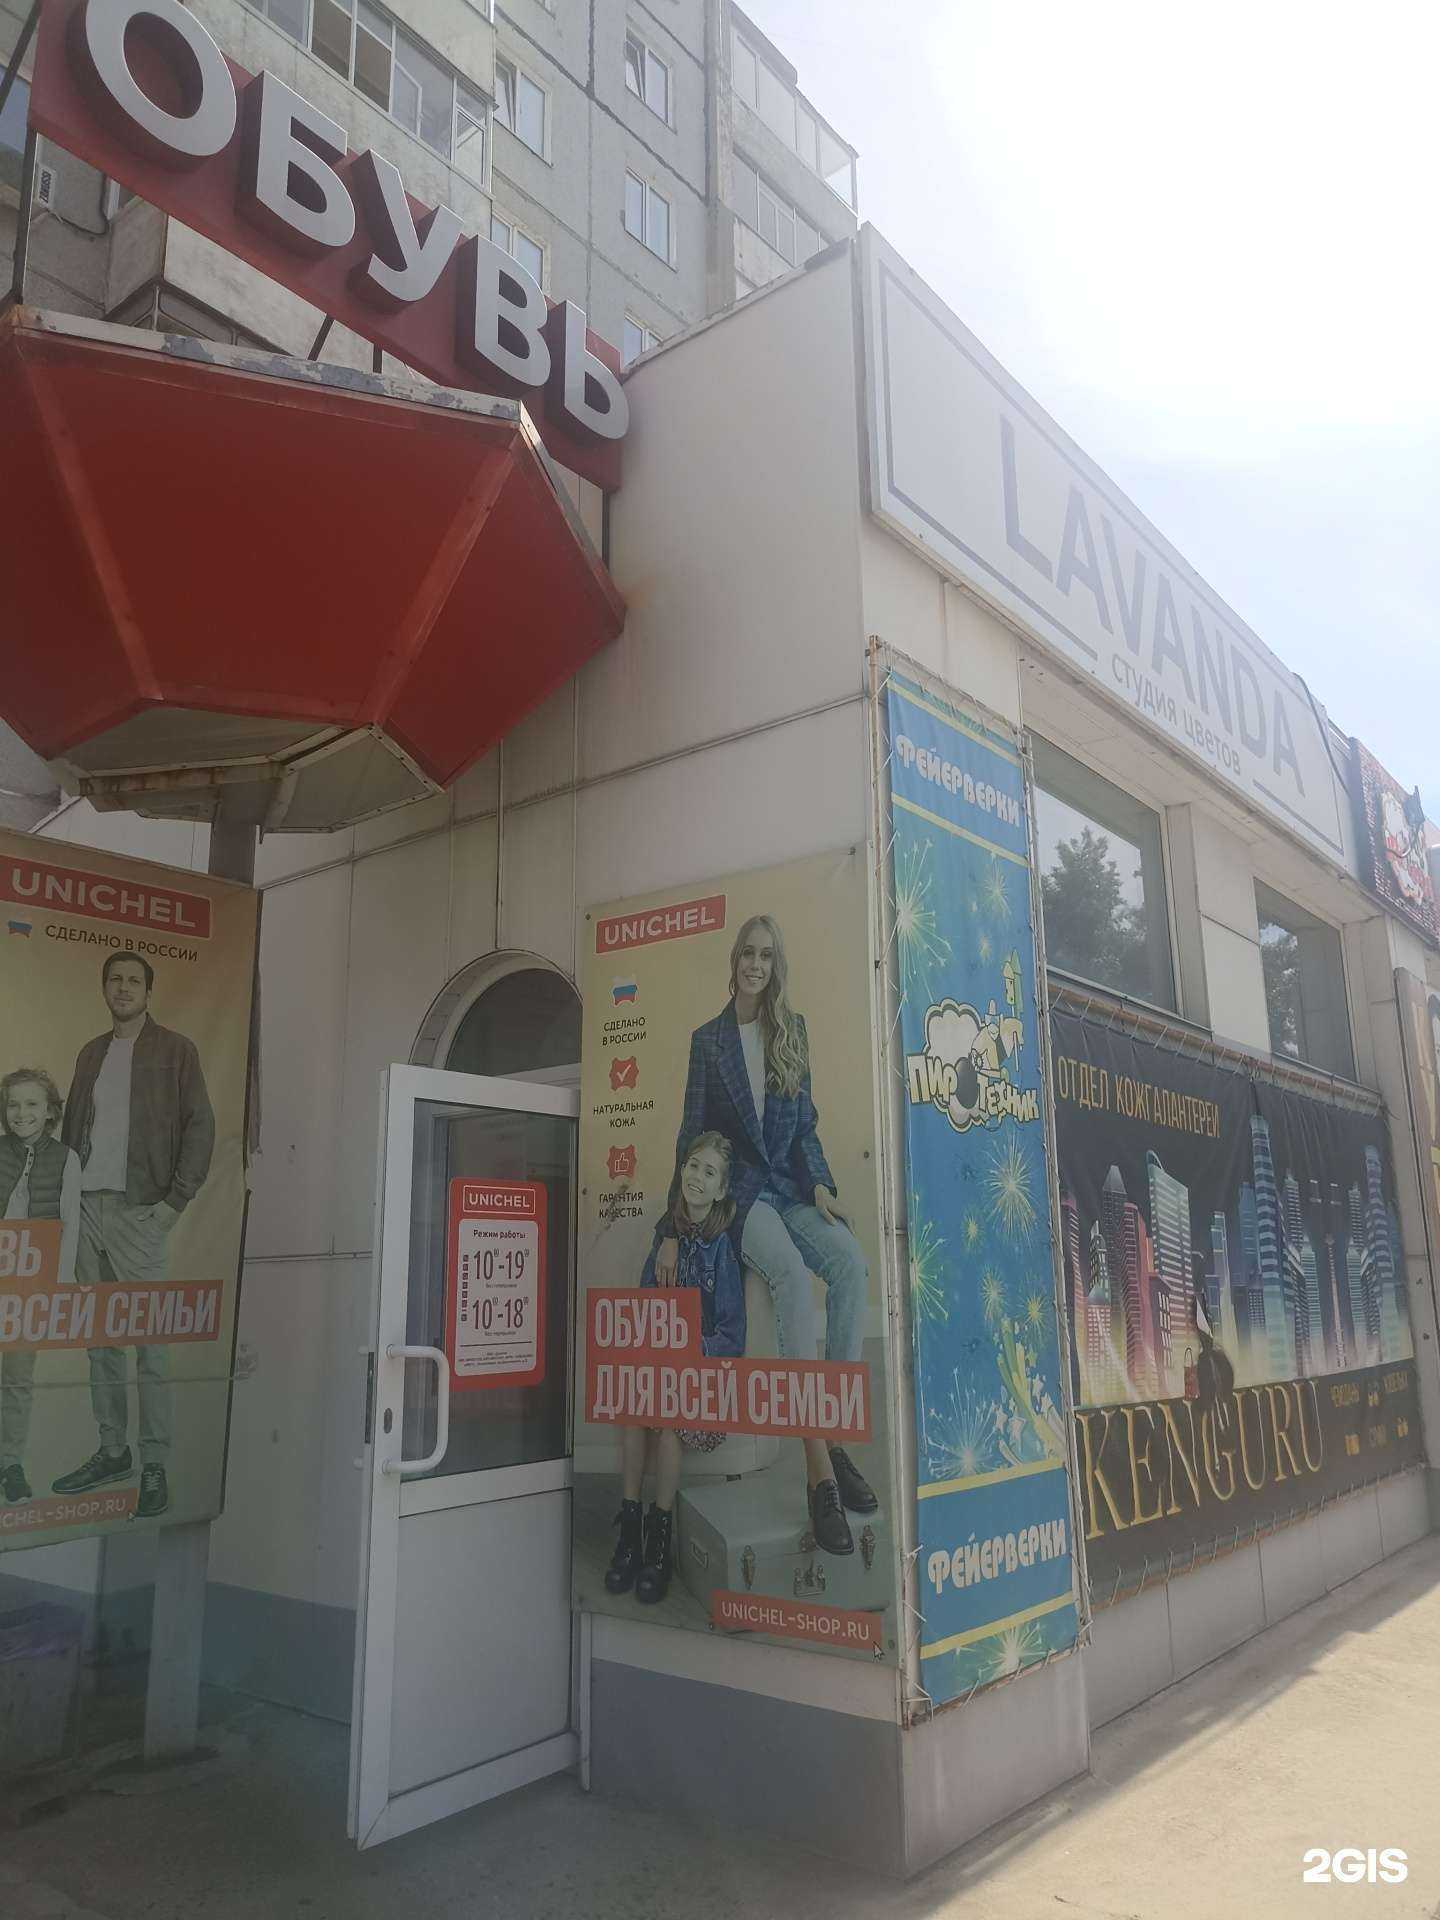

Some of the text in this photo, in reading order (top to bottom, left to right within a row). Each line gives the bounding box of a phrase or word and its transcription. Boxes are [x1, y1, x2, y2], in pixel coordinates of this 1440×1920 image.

[85, 0, 630, 441] ОБУВЬ
[1000, 410, 1307, 797] LAVANDA
[895, 730, 1021, 828] ФЕЙЕРВЕРКИ
[11, 867, 197, 928] UNICHEL
[45, 925, 198, 962] СДЕЛАНО В РОССИИ
[603, 905, 716, 945] UNICHEL
[602, 1031, 647, 1046] В РОССИИ
[603, 1017, 646, 1032] СДЕЛАНО
[1058, 1055, 1110, 1111] ОТДЕЛ
[593, 1100, 654, 1116] НАТУРАЛЬНАЯ
[610, 1117, 636, 1128] КОЖА
[469, 1193, 530, 1208] UNICHEL
[599, 1192, 644, 1203] ГАРАНТИЯ
[599, 1207, 643, 1218] КАЧЕСТВА
[473, 1229, 498, 1238] Режим
[0, 1286, 218, 1342] ВСЕЙ СЕМЬИ
[594, 1298, 689, 1349] ОБУВЬ
[592, 1361, 866, 1431] ДЛЯ ВСЕЙ СЕМЬИ
[1075, 1378, 1325, 1540] KENGURU
[927, 1517, 1067, 1594] ФЕЙЕРВЕРКИ
[720, 1601, 870, 1641] UNICHEL-SHOP.RU
